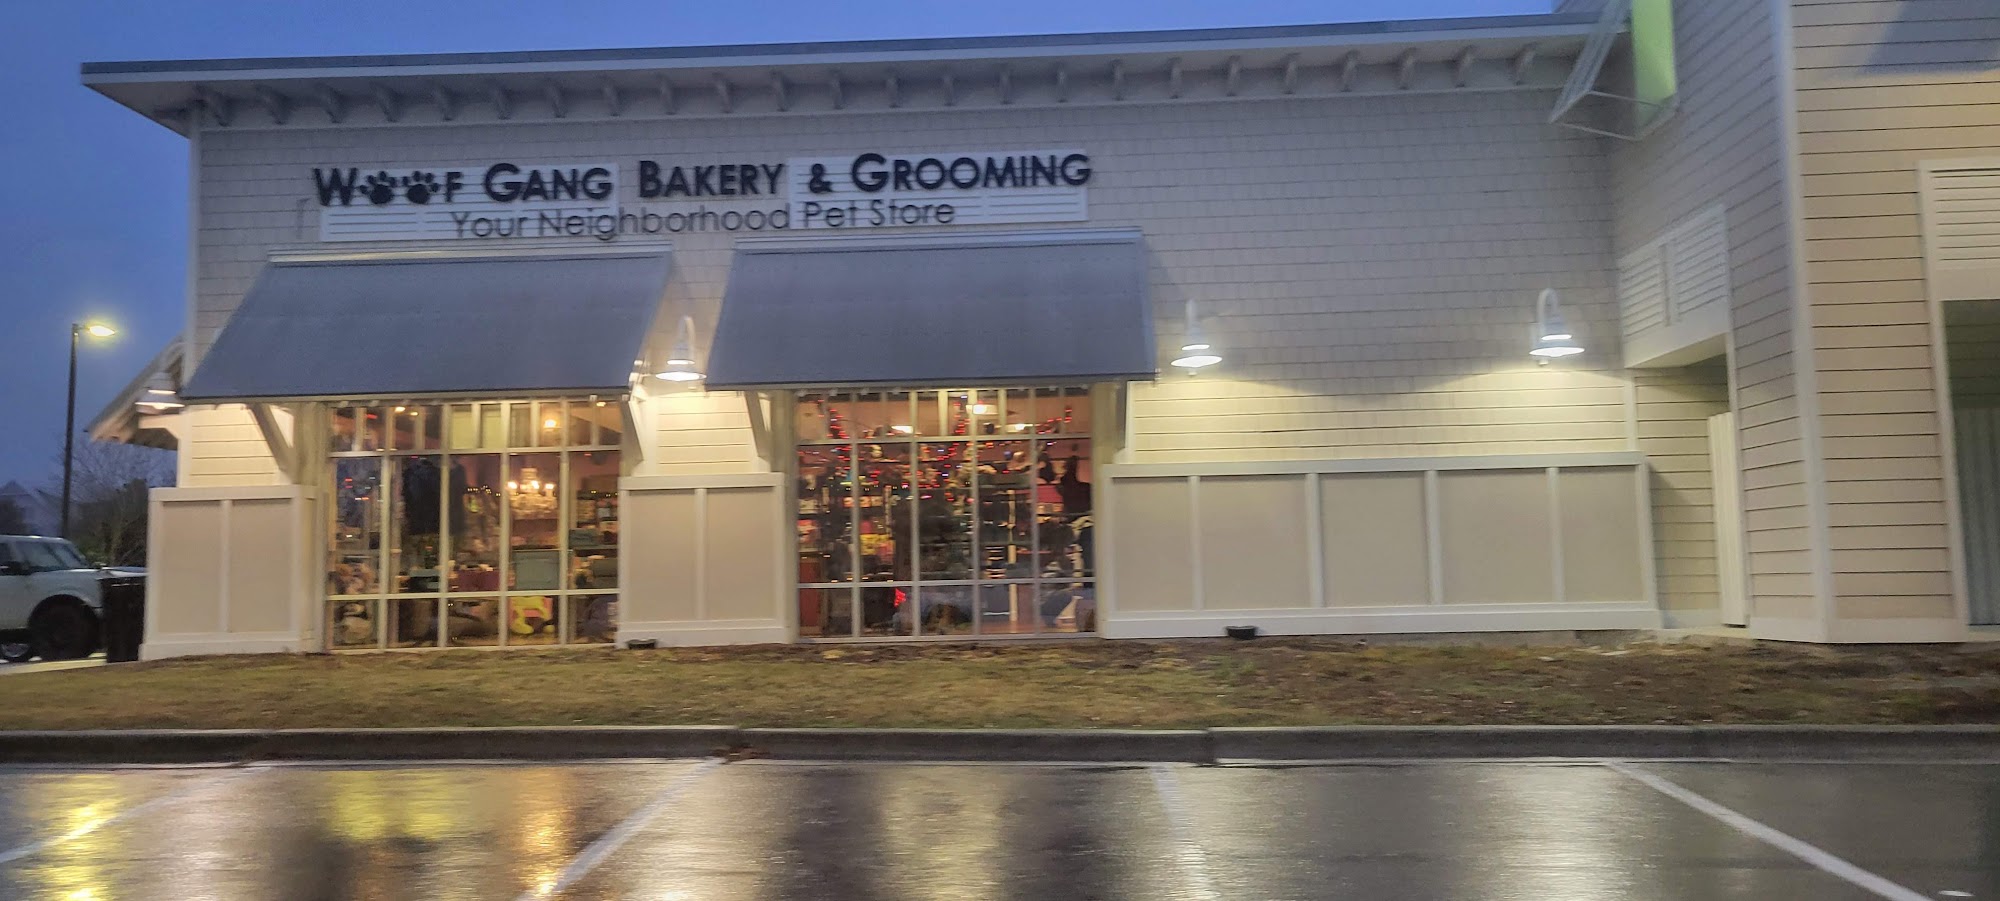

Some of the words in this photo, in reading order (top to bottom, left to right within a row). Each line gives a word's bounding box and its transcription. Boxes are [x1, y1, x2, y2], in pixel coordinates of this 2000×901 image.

[483, 162, 614, 203] GANG
[638, 160, 785, 199] BAKERY
[808, 163, 832, 194] &
[851, 153, 1092, 192] GROOMING
[450, 211, 528, 238] Your
[539, 203, 790, 241] Neighborhood
[802, 201, 858, 228] Pet
[870, 199, 956, 226] Store
